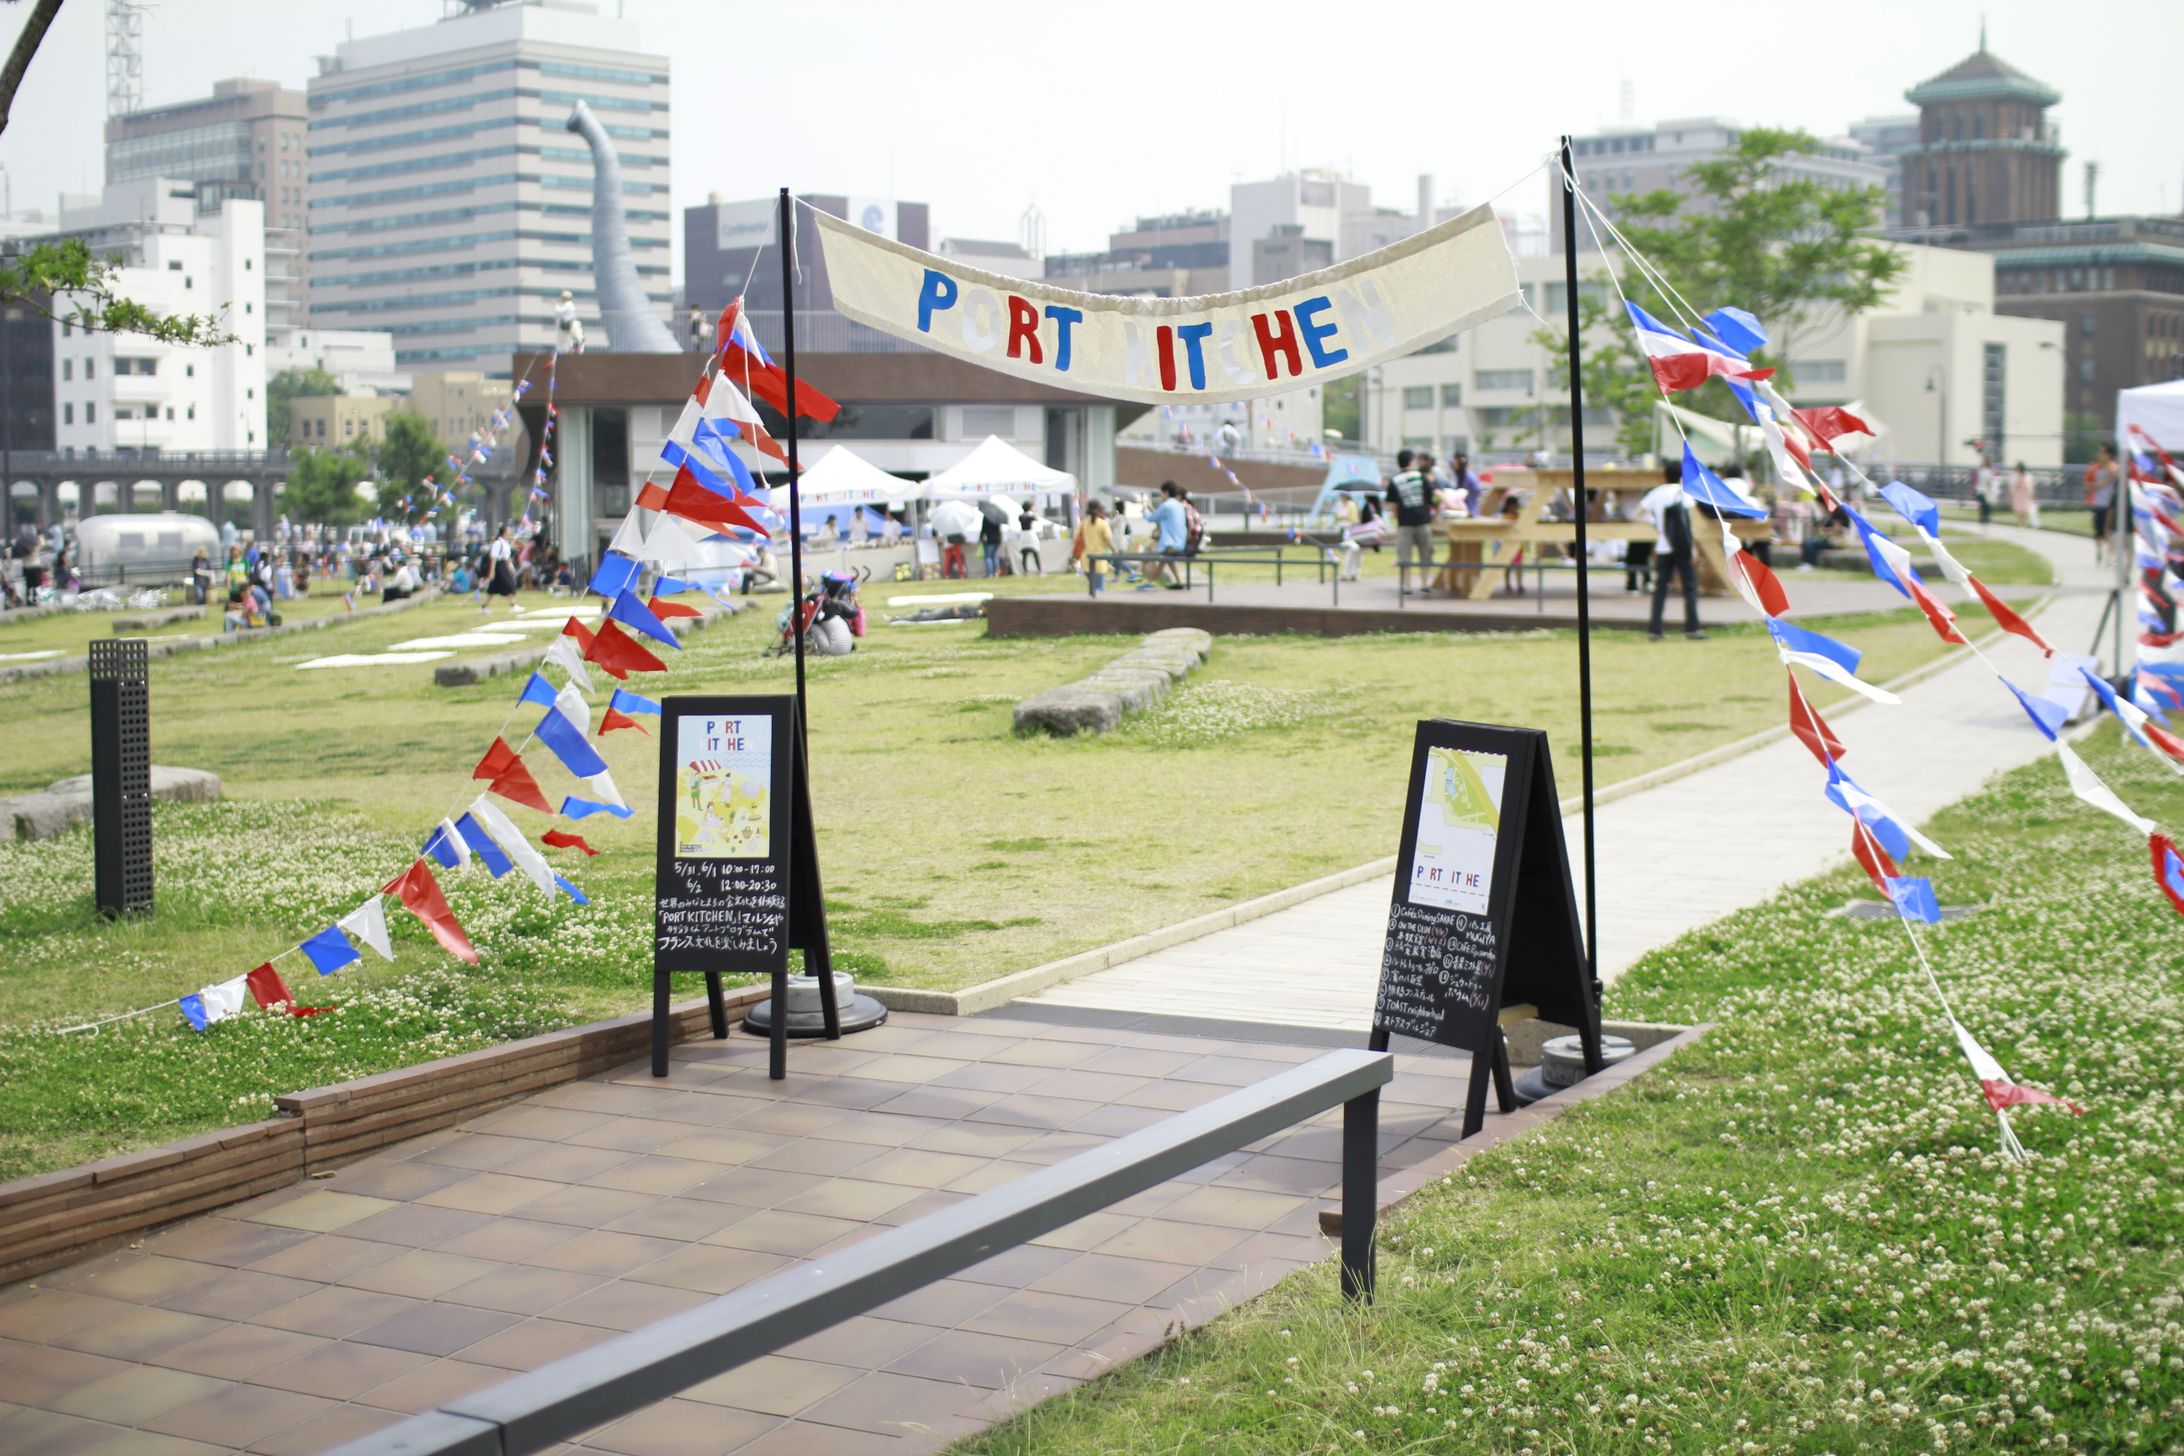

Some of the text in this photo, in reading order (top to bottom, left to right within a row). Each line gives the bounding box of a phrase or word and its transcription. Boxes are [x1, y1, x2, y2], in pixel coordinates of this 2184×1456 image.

[917, 268, 1083, 372] PORT
[687, 878, 702, 893] 6/2
[657, 936, 778, 955] フランス文化を楽しみましょう
